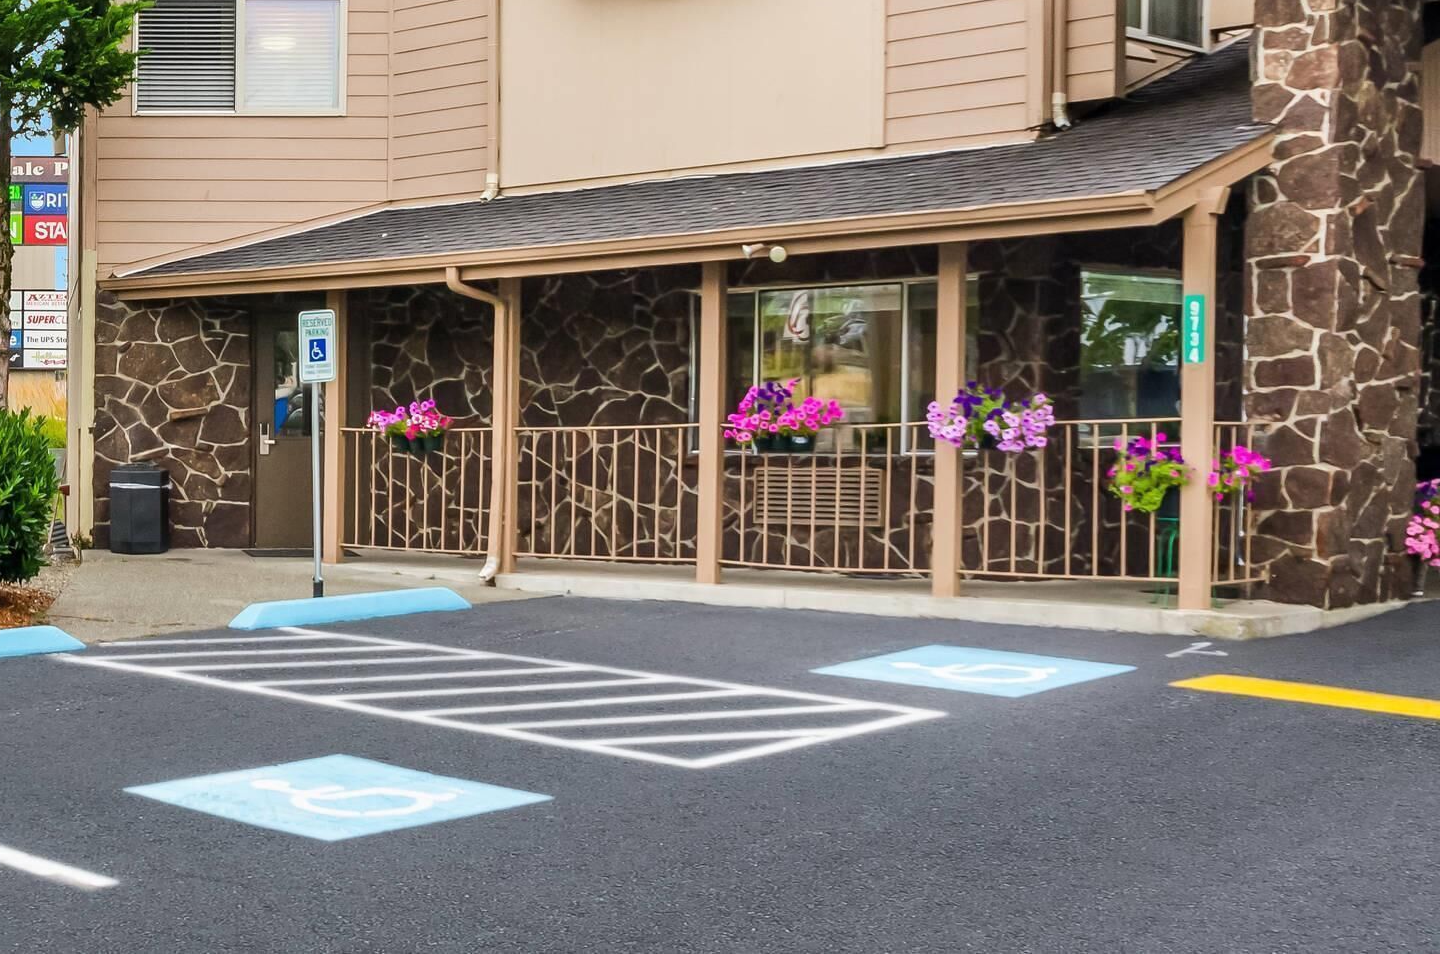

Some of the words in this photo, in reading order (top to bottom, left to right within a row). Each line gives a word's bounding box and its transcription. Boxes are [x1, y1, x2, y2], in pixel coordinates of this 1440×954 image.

[302, 317, 332, 328] RESERVED
[305, 328, 329, 337] PARKING
[1189, 300, 1200, 363] 9734
